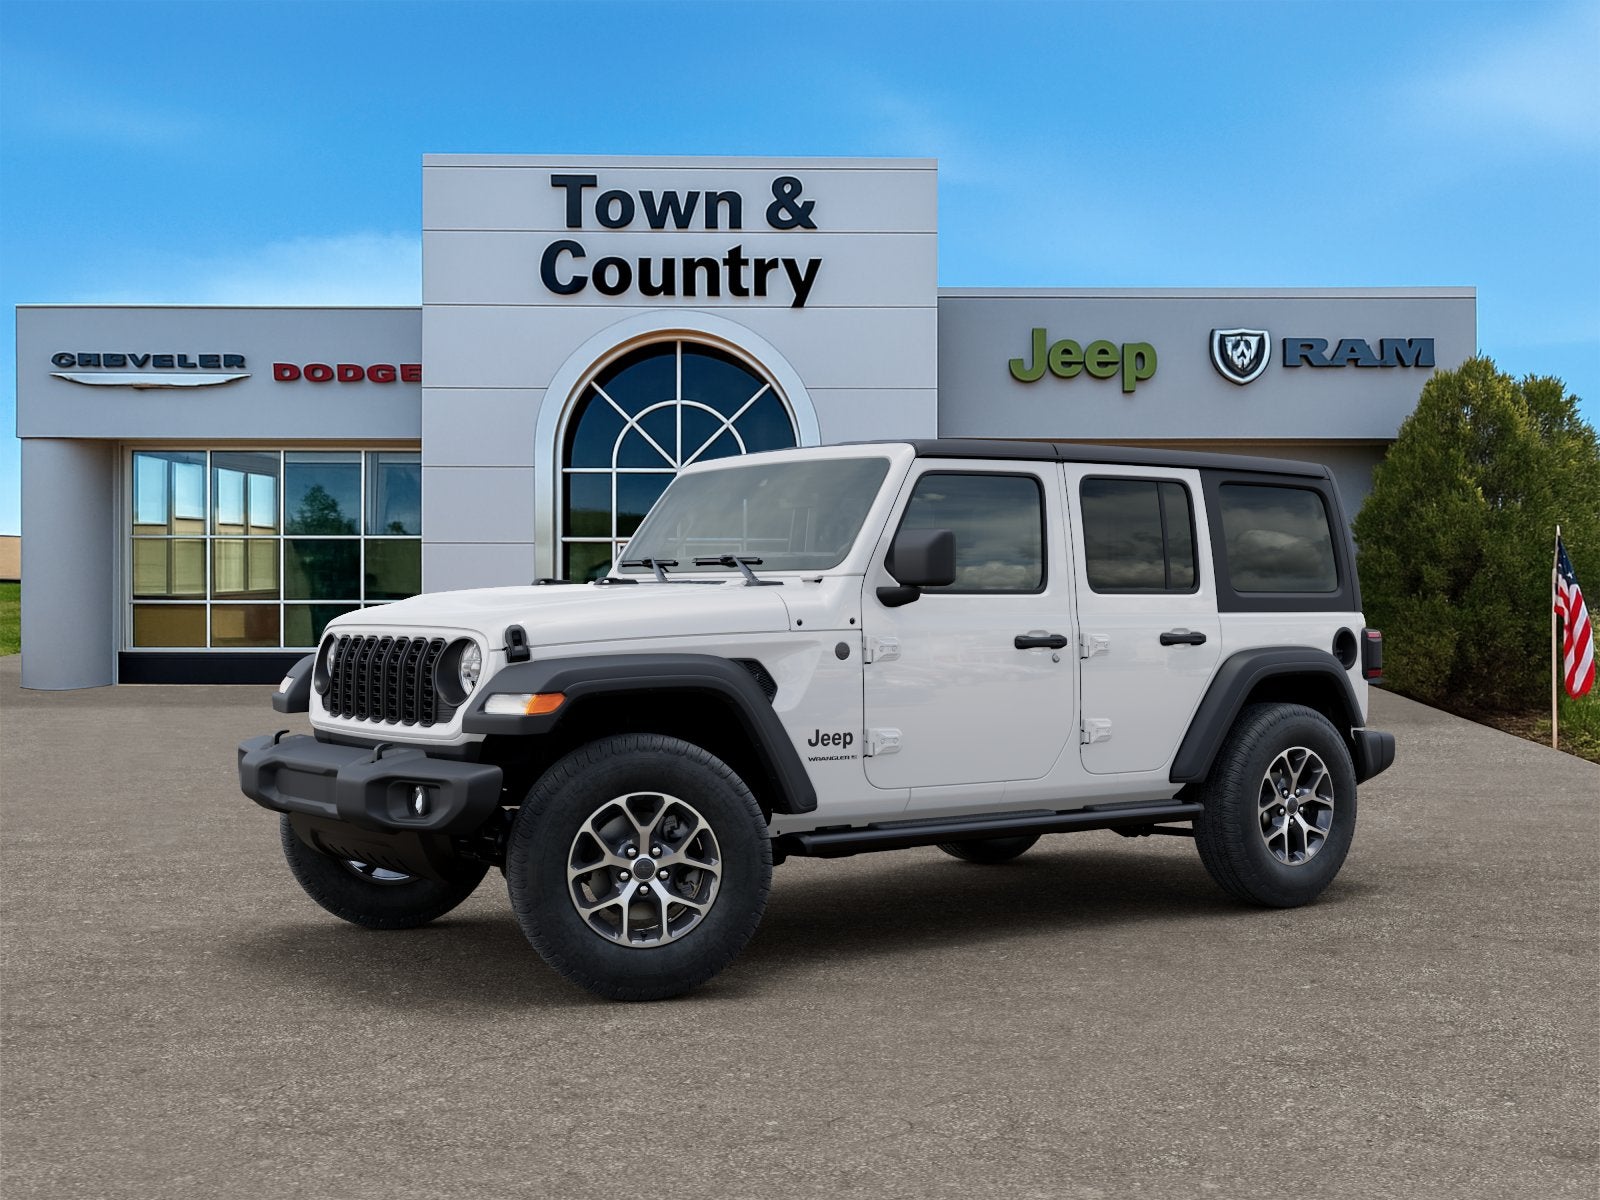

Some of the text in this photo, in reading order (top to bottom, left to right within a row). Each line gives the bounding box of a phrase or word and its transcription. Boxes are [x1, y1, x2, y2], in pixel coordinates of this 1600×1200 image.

[550, 174, 818, 229] Town &
[540, 239, 822, 308] Country
[273, 362, 422, 383] DODGE
[1008, 328, 1157, 393] Jeep
[1282, 337, 1435, 368] RAM
[808, 729, 853, 749] Jeep
